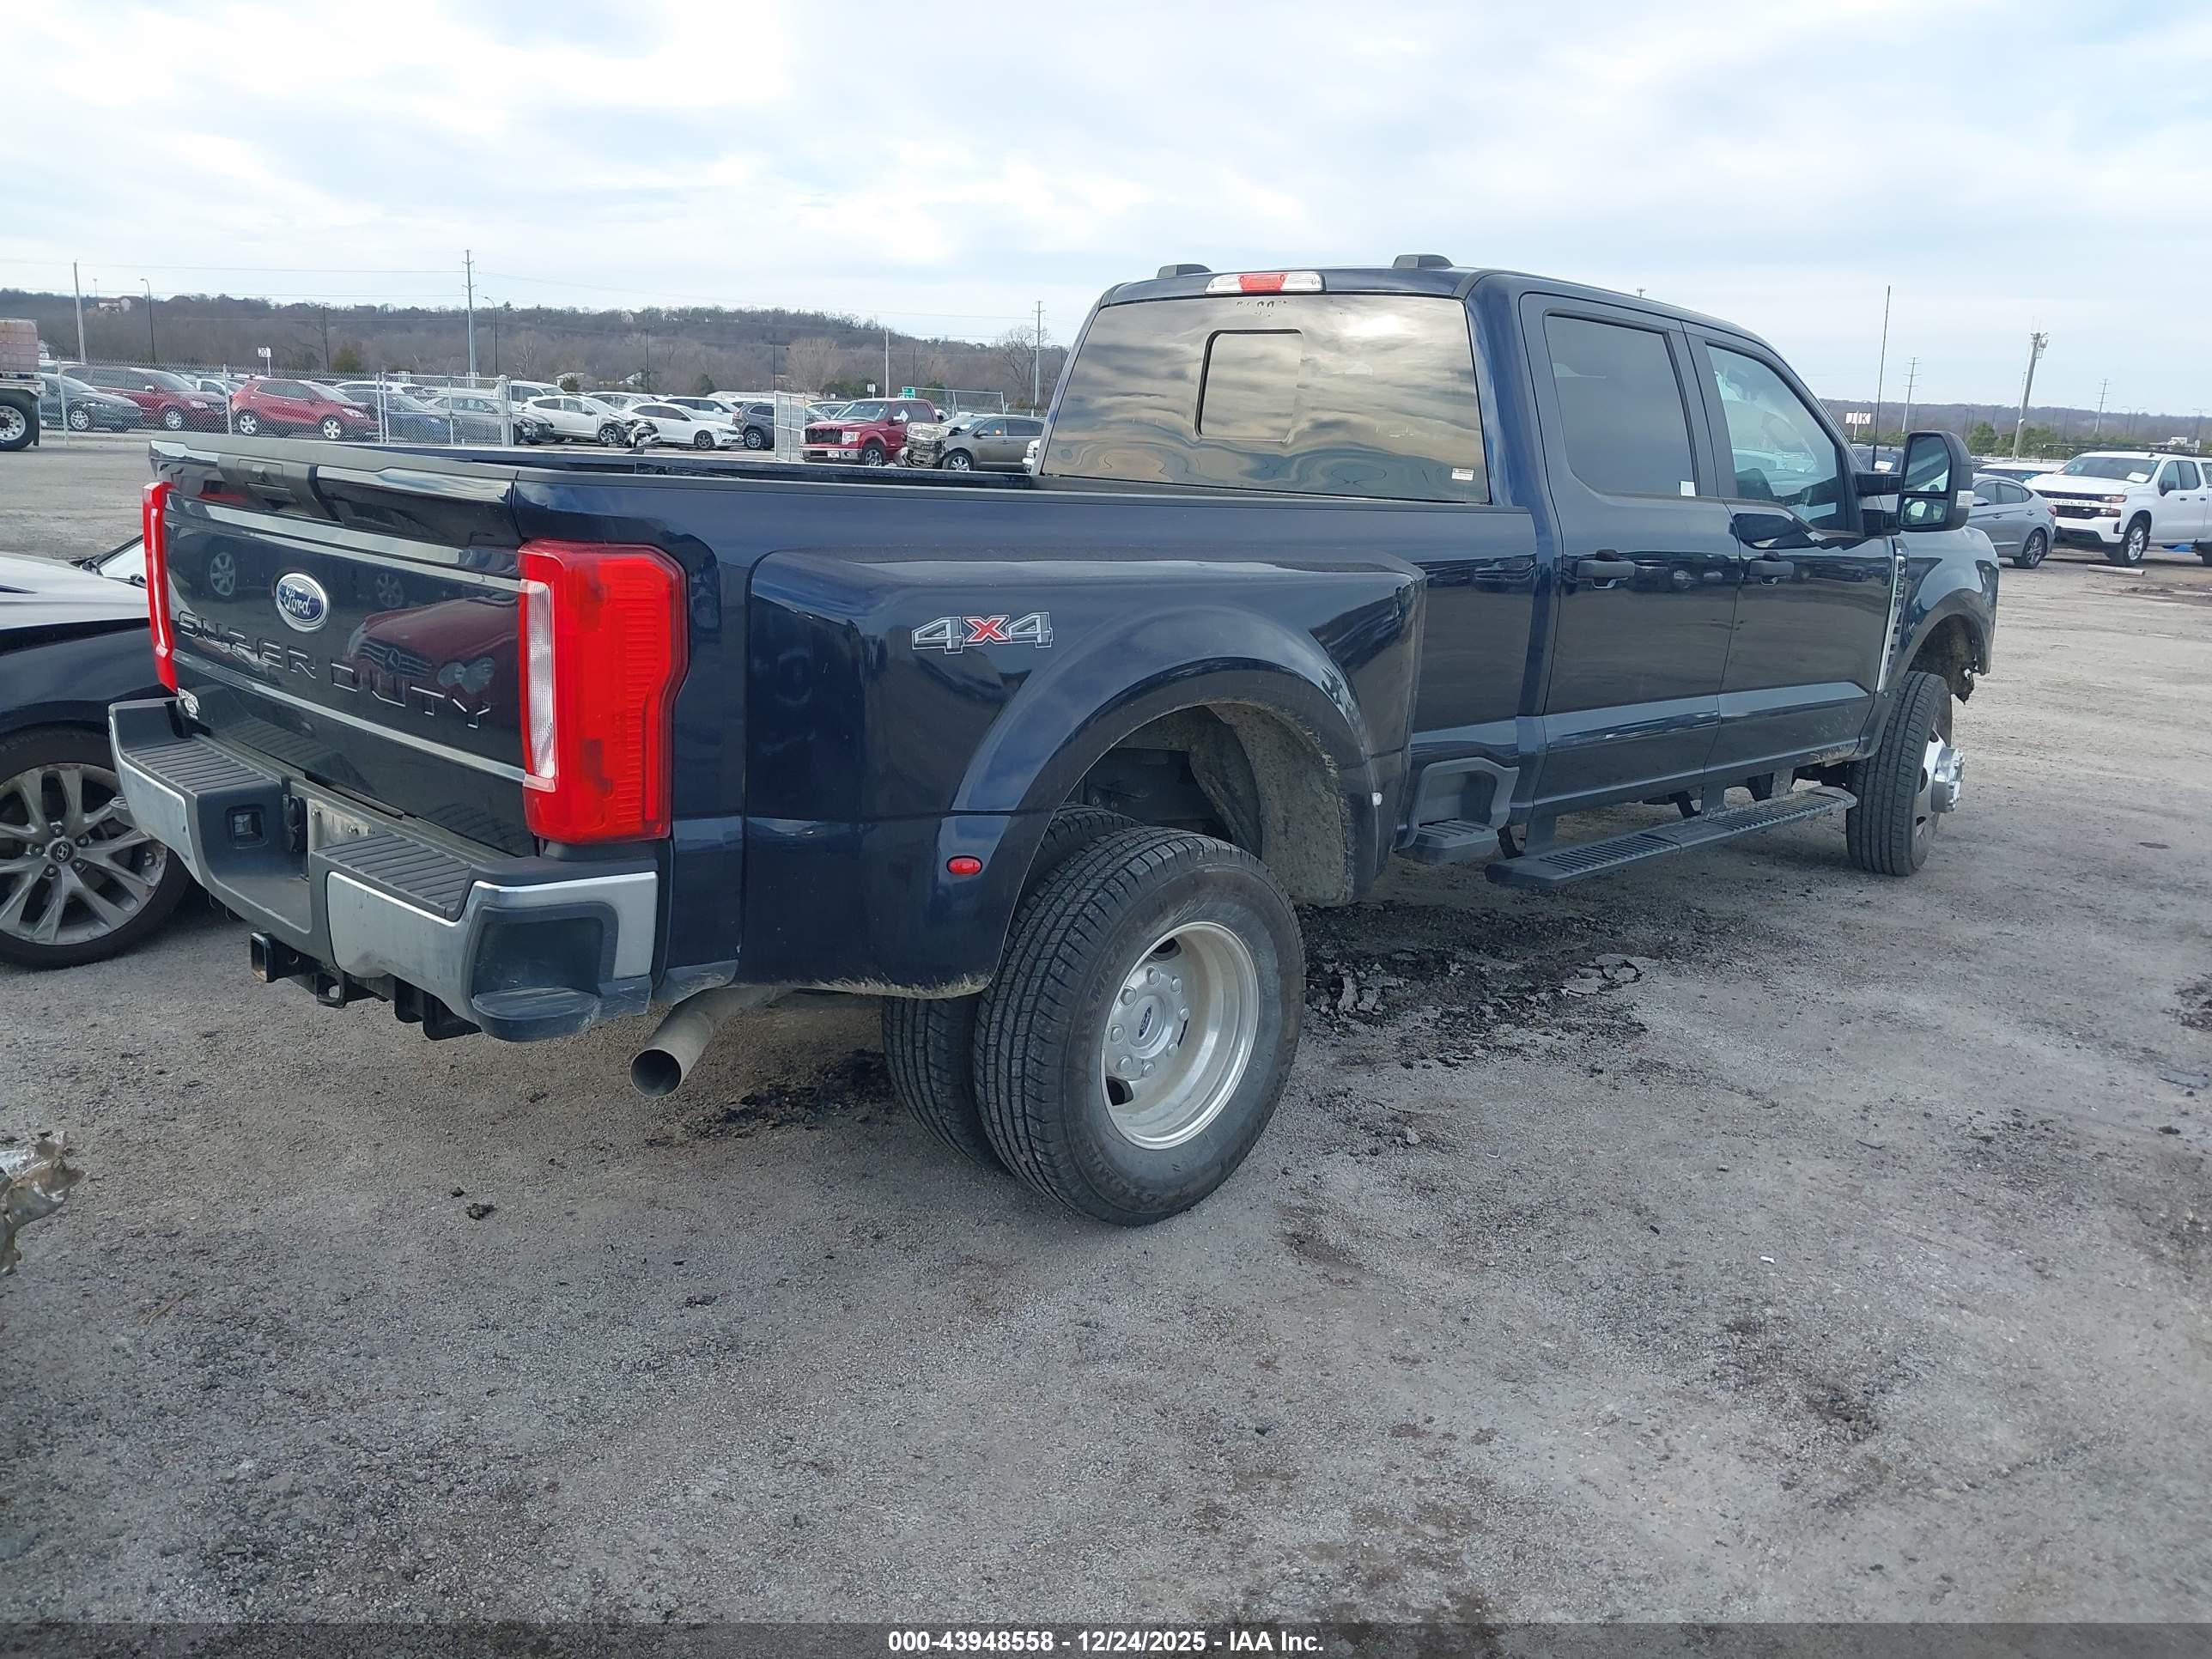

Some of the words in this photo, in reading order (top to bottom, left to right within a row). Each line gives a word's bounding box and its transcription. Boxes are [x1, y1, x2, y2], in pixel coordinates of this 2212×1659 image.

[282, 583, 313, 617] Ford
[177, 610, 317, 680] SUPER
[330, 659, 491, 729] DUTY
